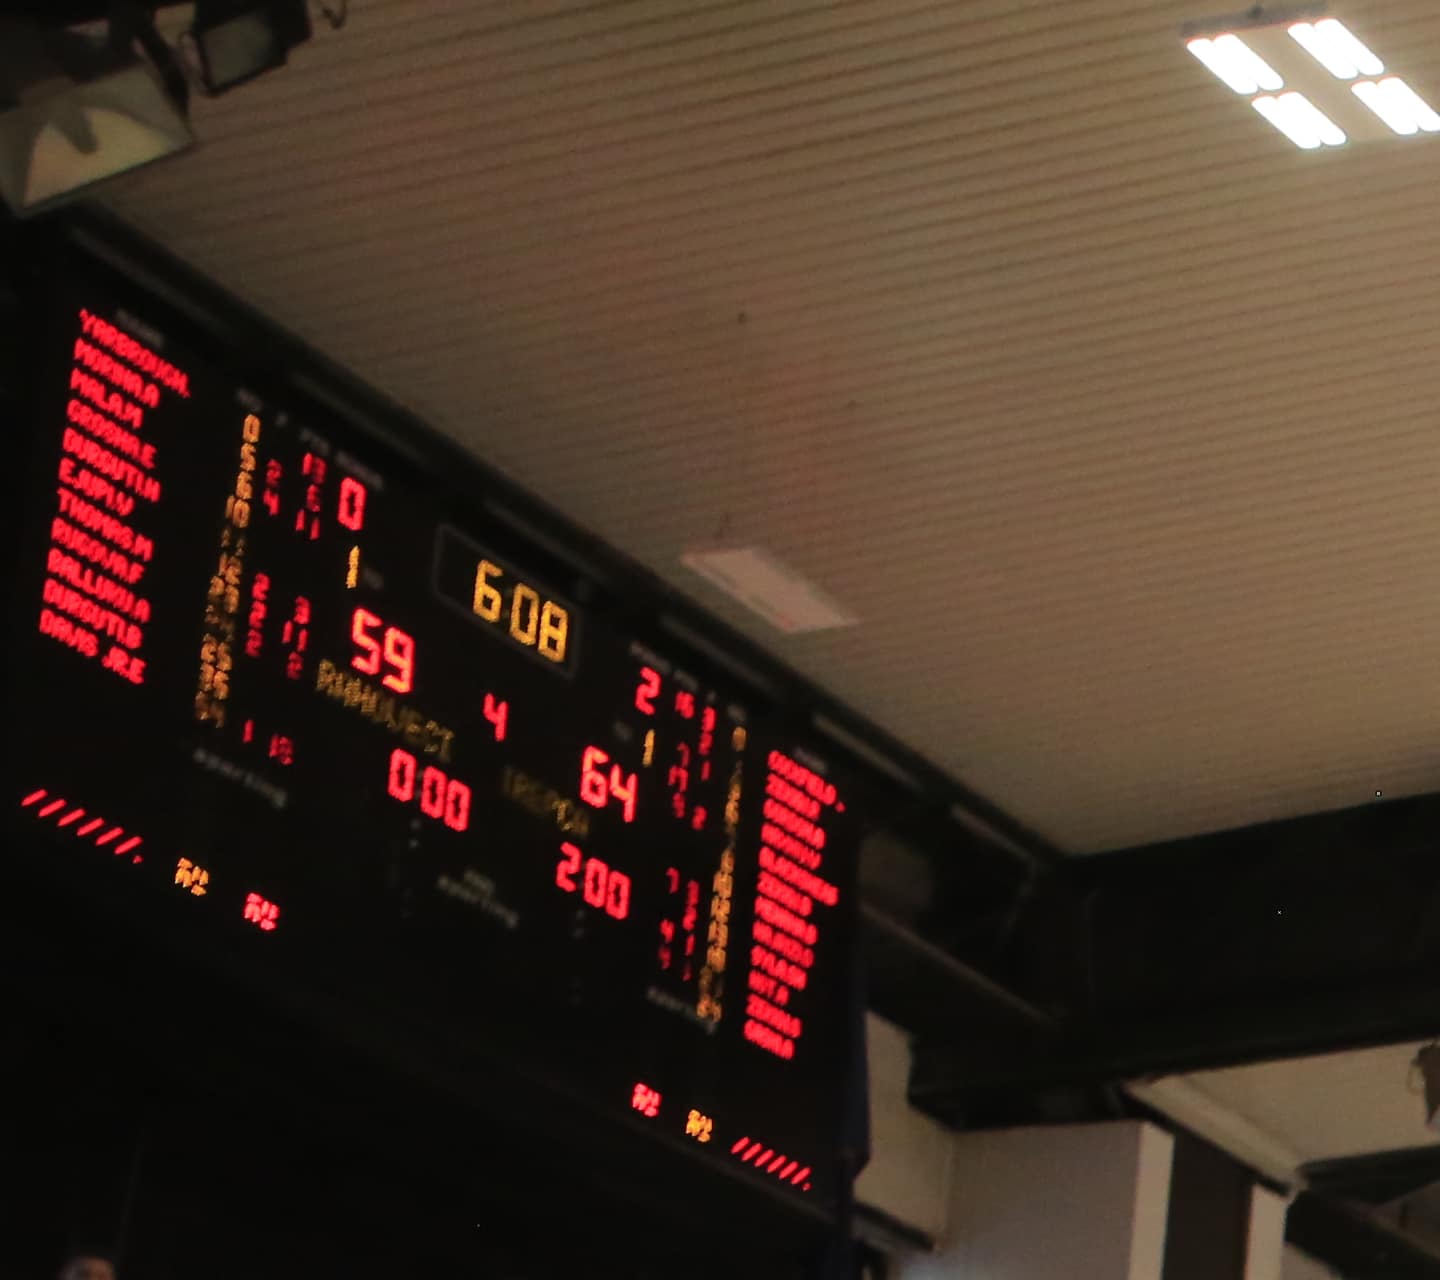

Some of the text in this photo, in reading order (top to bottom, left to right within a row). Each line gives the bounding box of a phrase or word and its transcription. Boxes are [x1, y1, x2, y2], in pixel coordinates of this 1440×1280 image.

[337, 475, 367, 531] 0
[346, 544, 361, 590] 1
[352, 607, 416, 694] 59
[483, 691, 510, 742] 4
[635, 665, 662, 716] 2
[580, 745, 638, 824] 64
